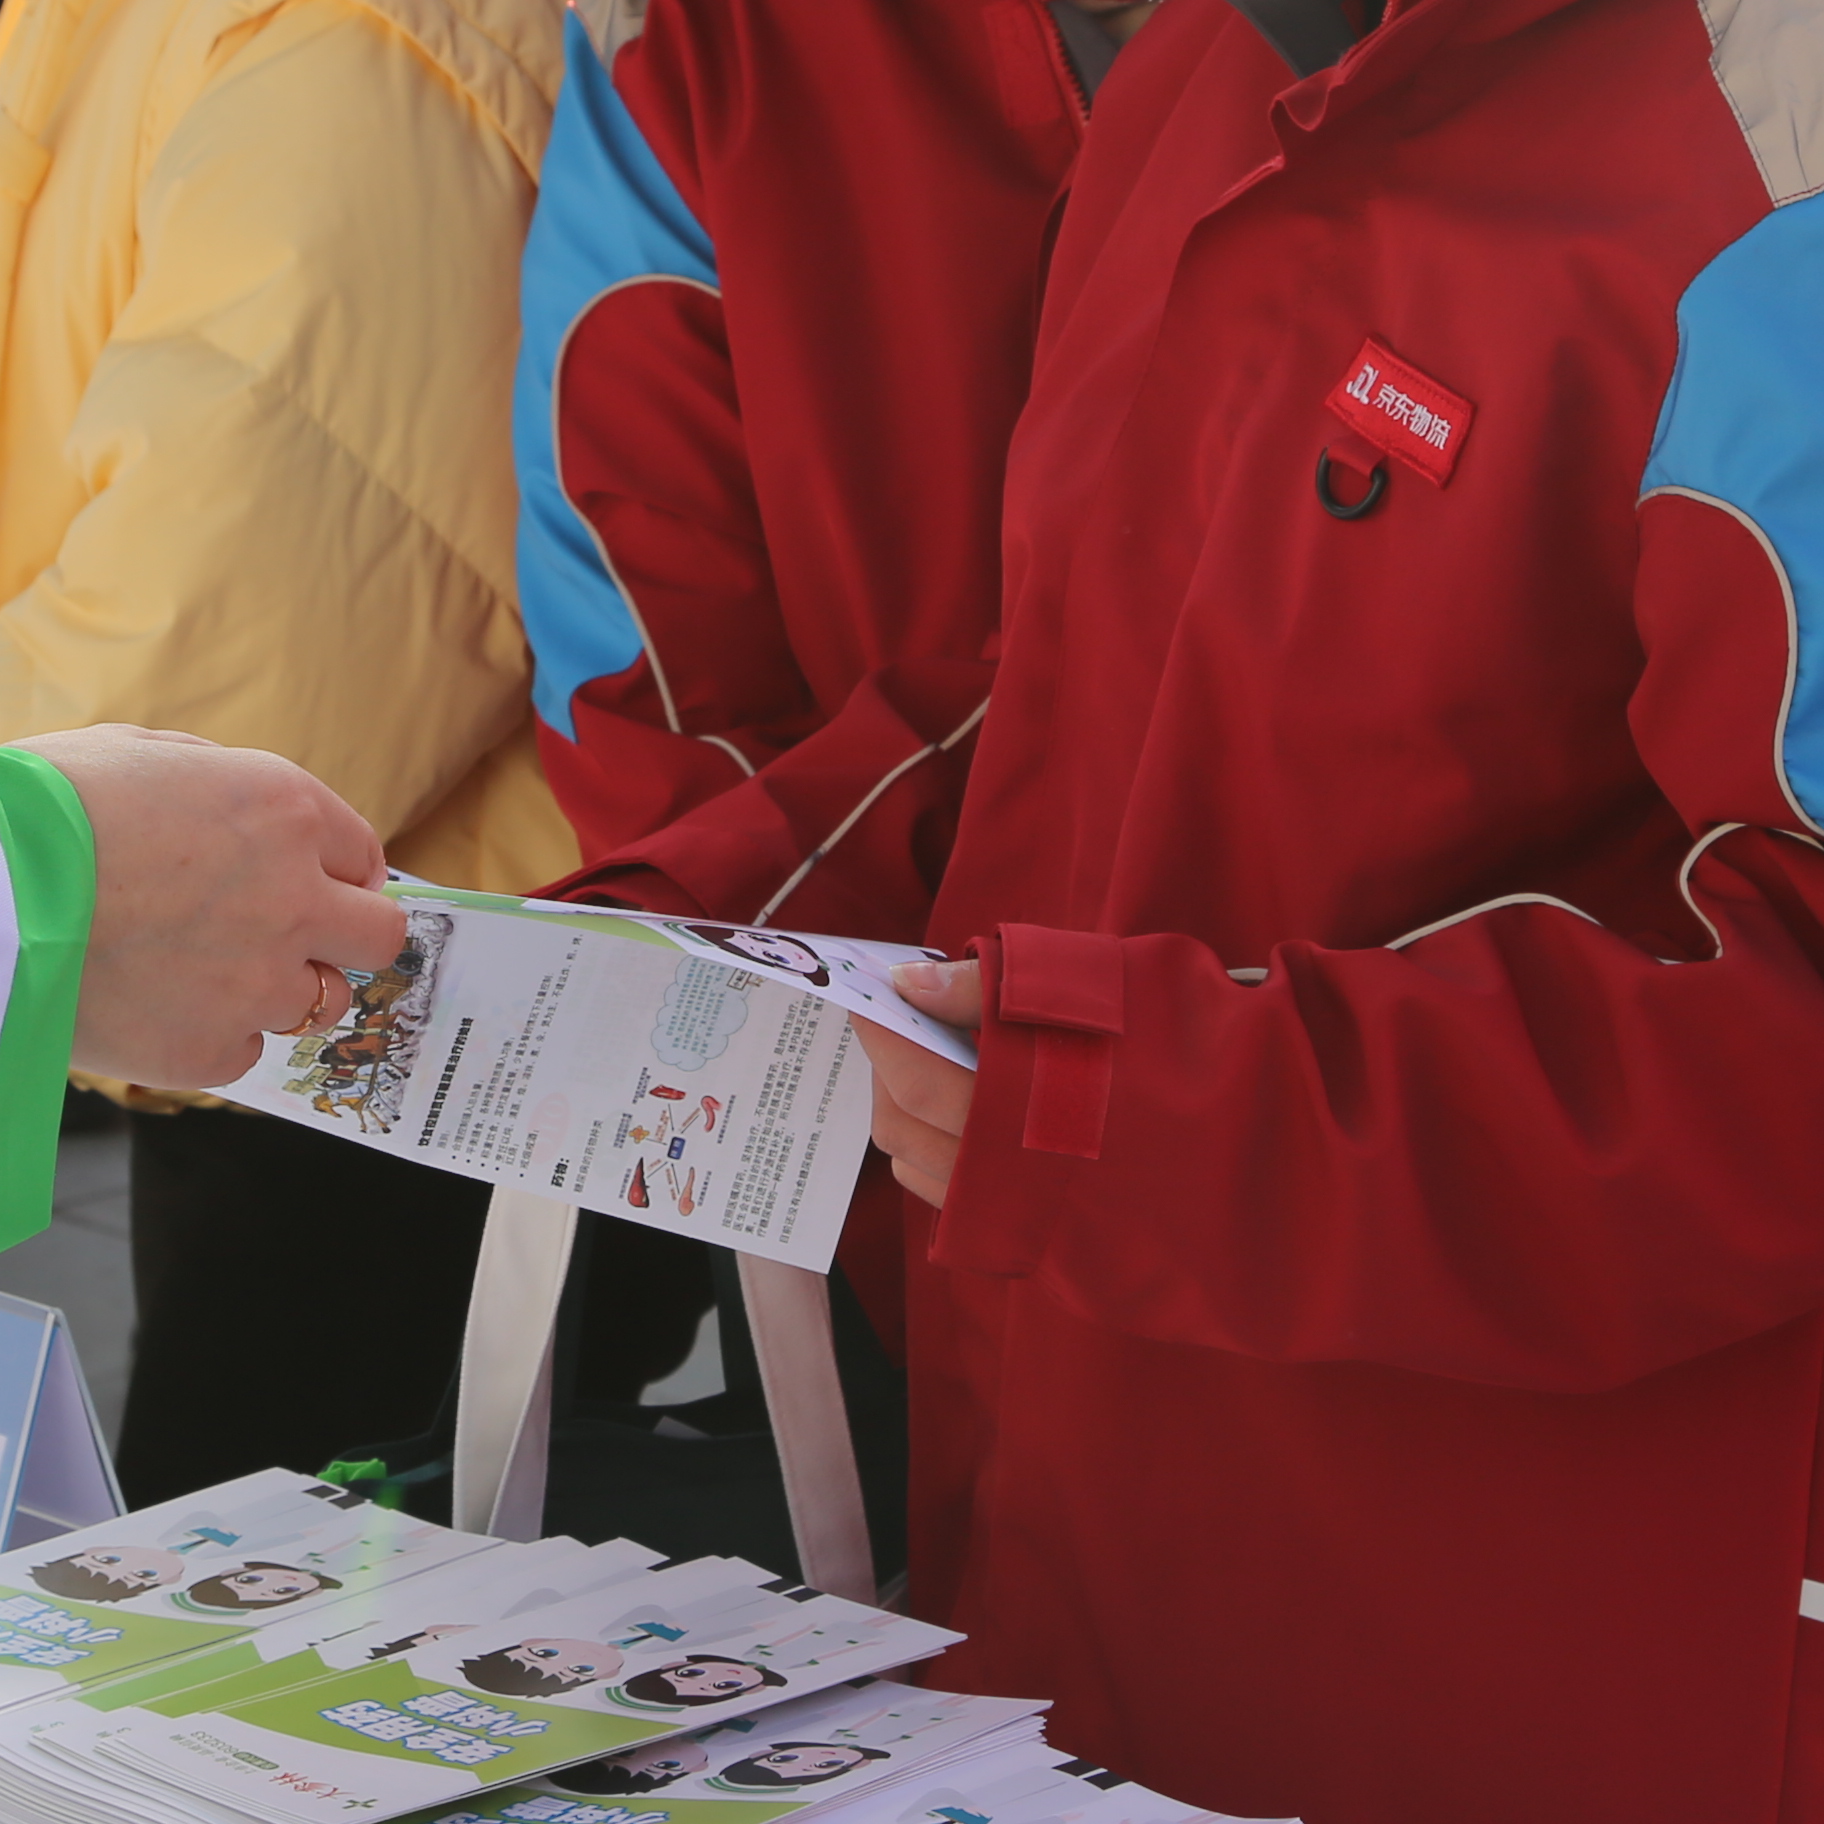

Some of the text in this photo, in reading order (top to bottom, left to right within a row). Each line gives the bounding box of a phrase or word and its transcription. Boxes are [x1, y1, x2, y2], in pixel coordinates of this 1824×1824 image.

[1372, 383, 1452, 450] 京东物流
[417, 1015, 474, 1147] 饮食控制贯穿糖尿病治疗的始终
[549, 1156, 571, 1187] 药物：
[570, 1118, 606, 1193] 糖尿病的药物种类
[317, 1699, 516, 1766] 安全用药
[399, 1689, 551, 1739] 小科普
